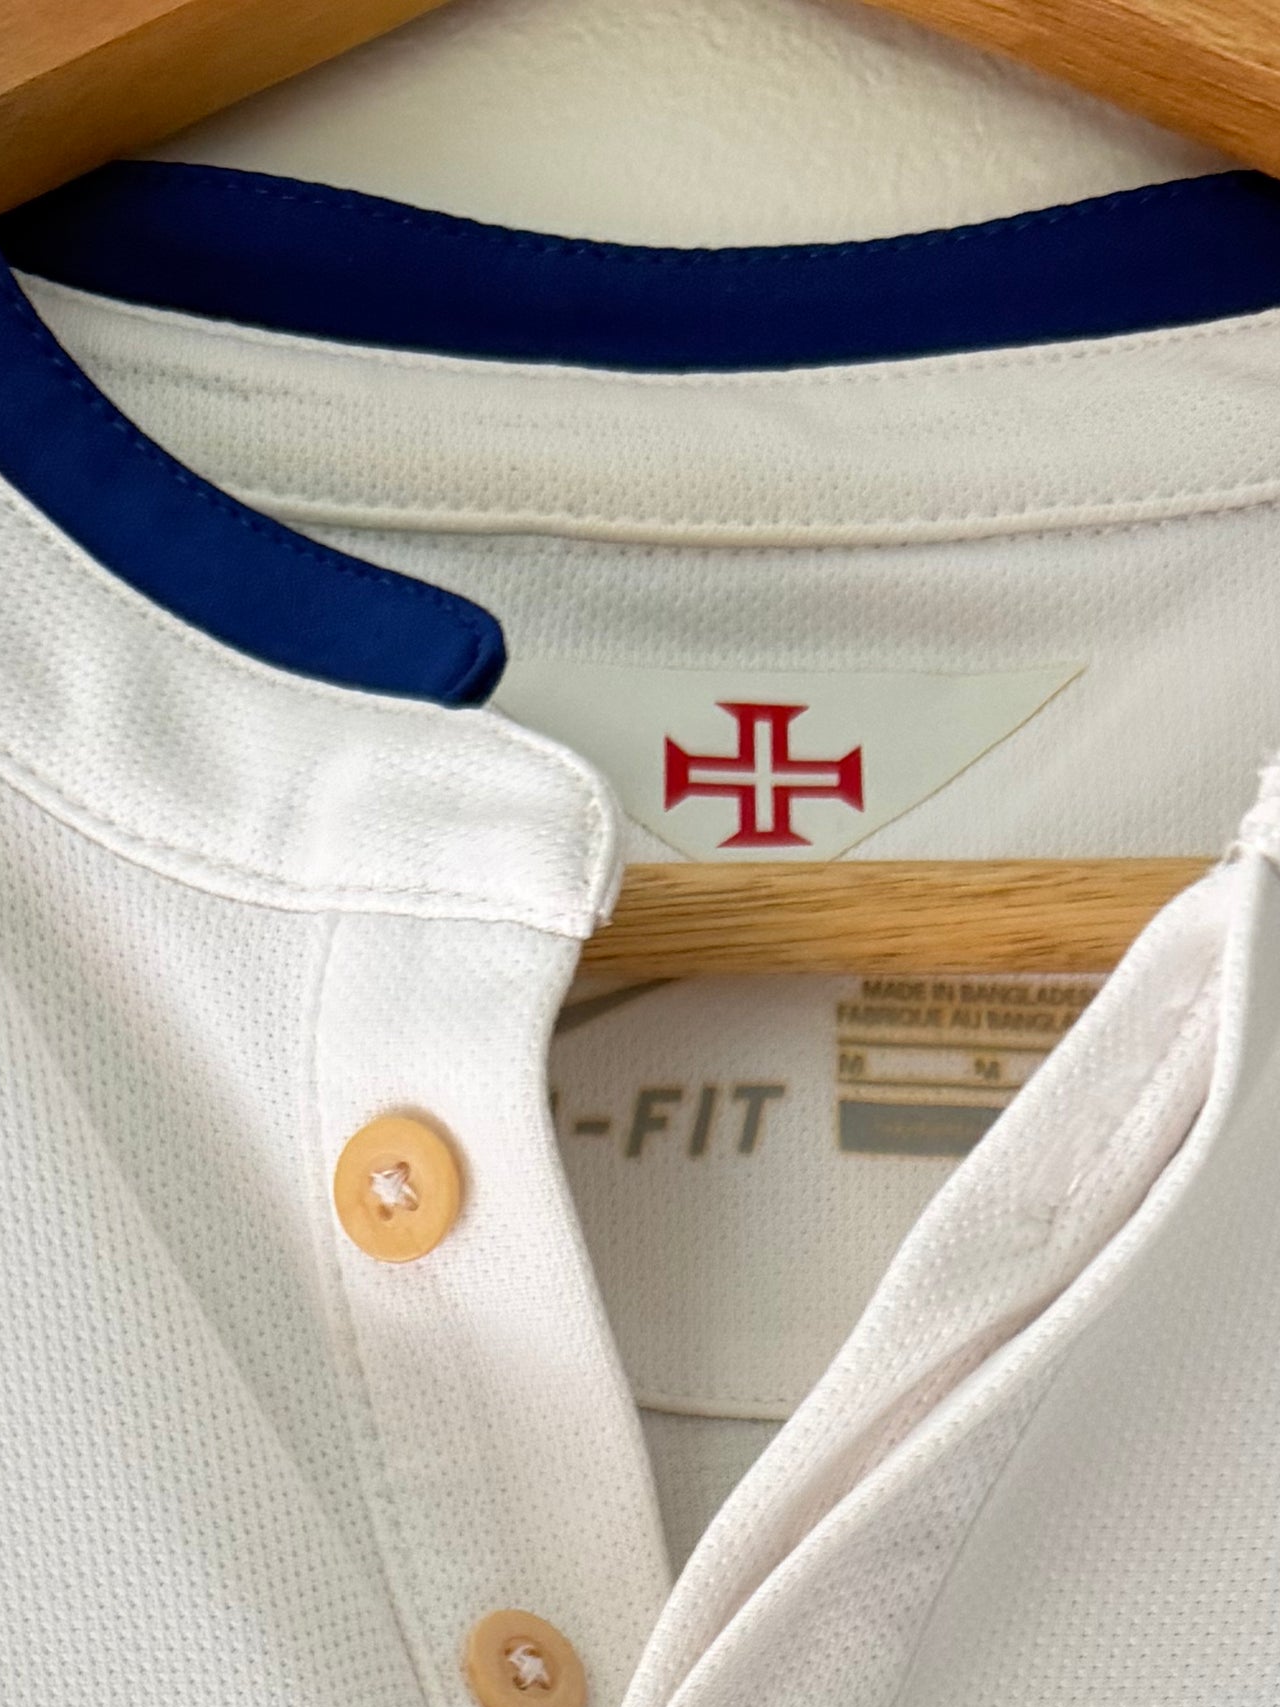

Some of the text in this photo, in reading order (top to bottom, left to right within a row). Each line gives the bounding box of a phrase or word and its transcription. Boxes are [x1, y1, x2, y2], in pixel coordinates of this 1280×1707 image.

[862, 979, 925, 1000] MADE
[931, 981, 954, 1003] IN
[950, 1008, 982, 1029] AU
[987, 1009, 1080, 1034] BANGLA
[549, 1083, 786, 1157] -FIT
